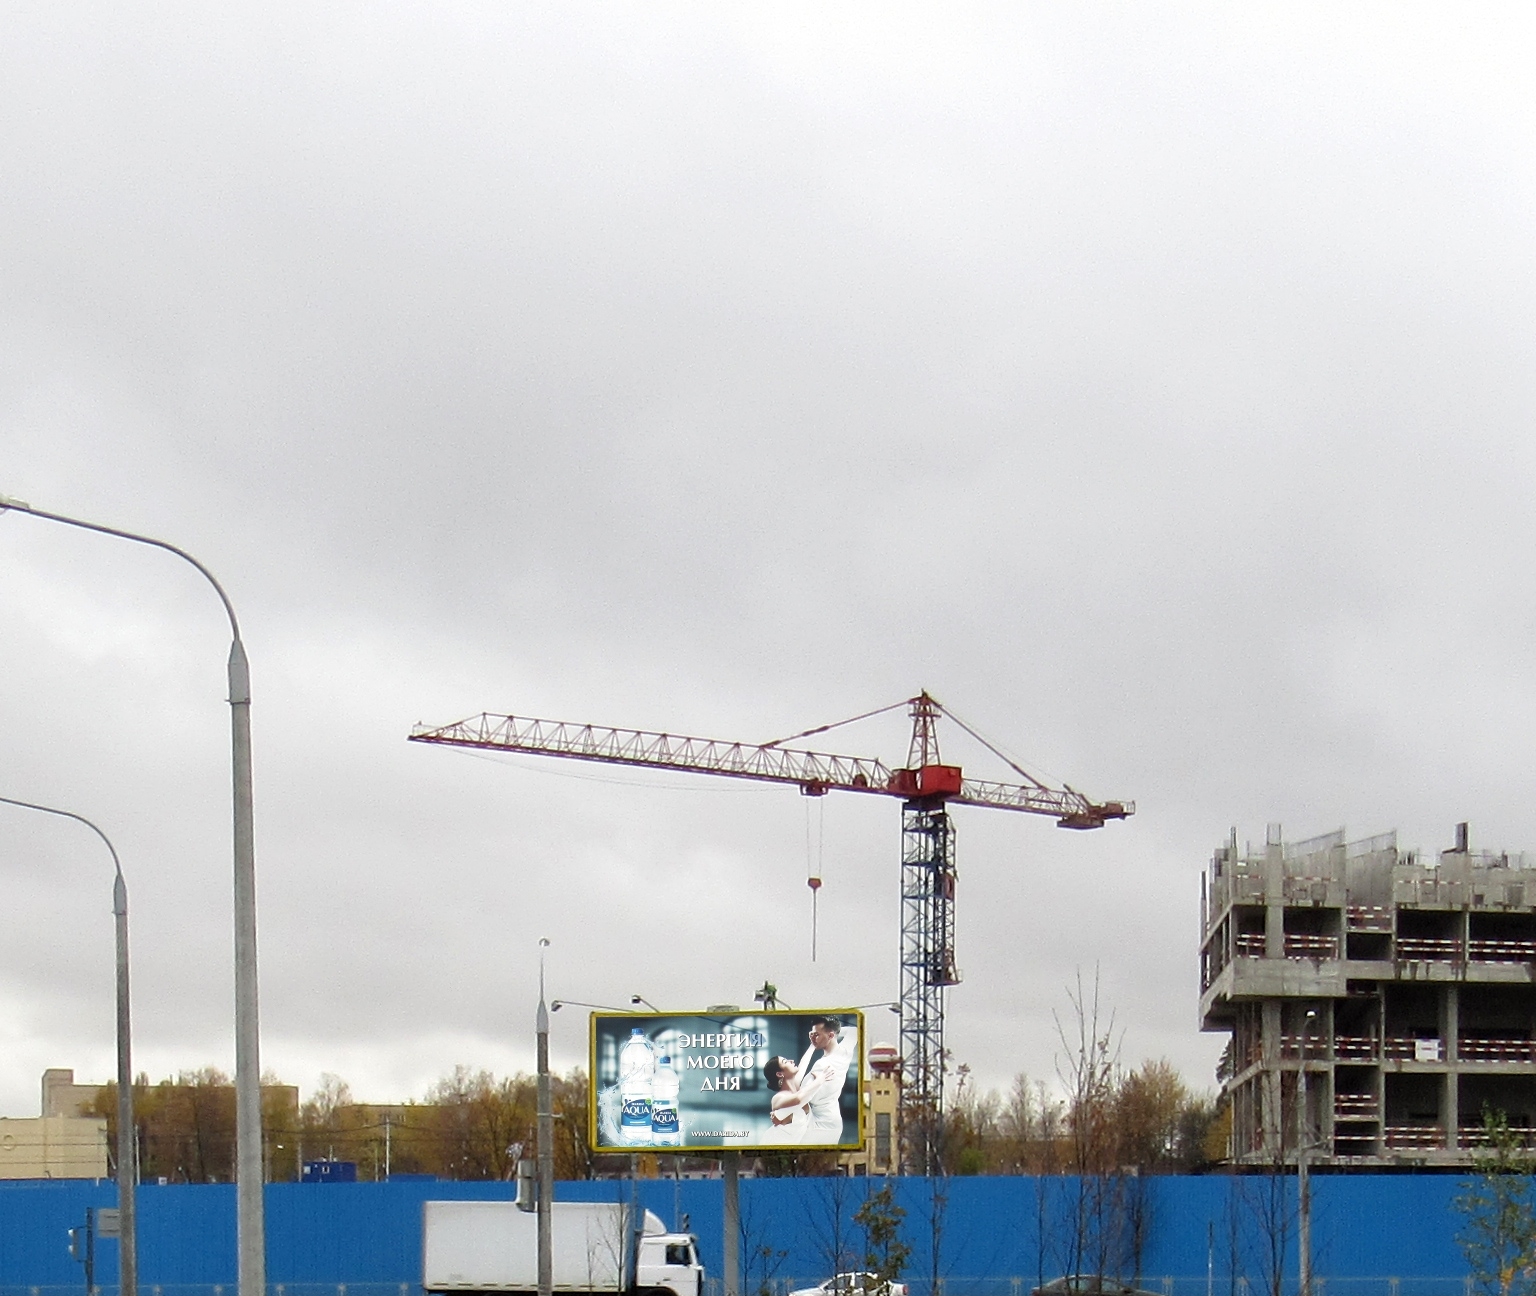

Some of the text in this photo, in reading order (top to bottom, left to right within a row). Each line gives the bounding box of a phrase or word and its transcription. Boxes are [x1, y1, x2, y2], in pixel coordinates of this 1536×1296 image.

[678, 1033, 763, 1048] ЭНЕРГИЯ
[686, 1055, 755, 1070] МОЕГО
[700, 1076, 741, 1093] ДНЯ
[623, 1106, 650, 1116] AQUA
[654, 1114, 676, 1124] AQUA
